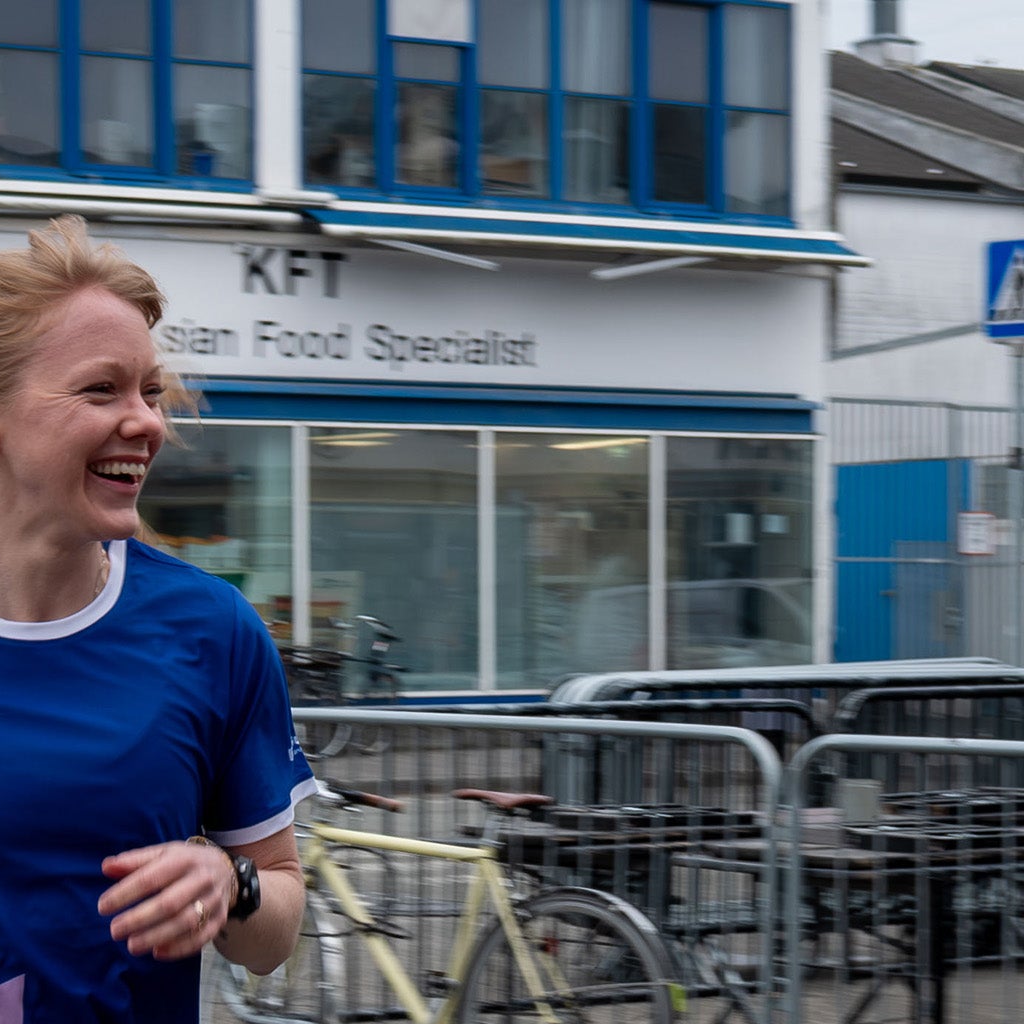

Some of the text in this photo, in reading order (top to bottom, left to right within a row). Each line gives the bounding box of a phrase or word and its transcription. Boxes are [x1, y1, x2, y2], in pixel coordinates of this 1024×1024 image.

[241, 246, 347, 299] KFT
[160, 318, 537, 370] sian Food Specialist
